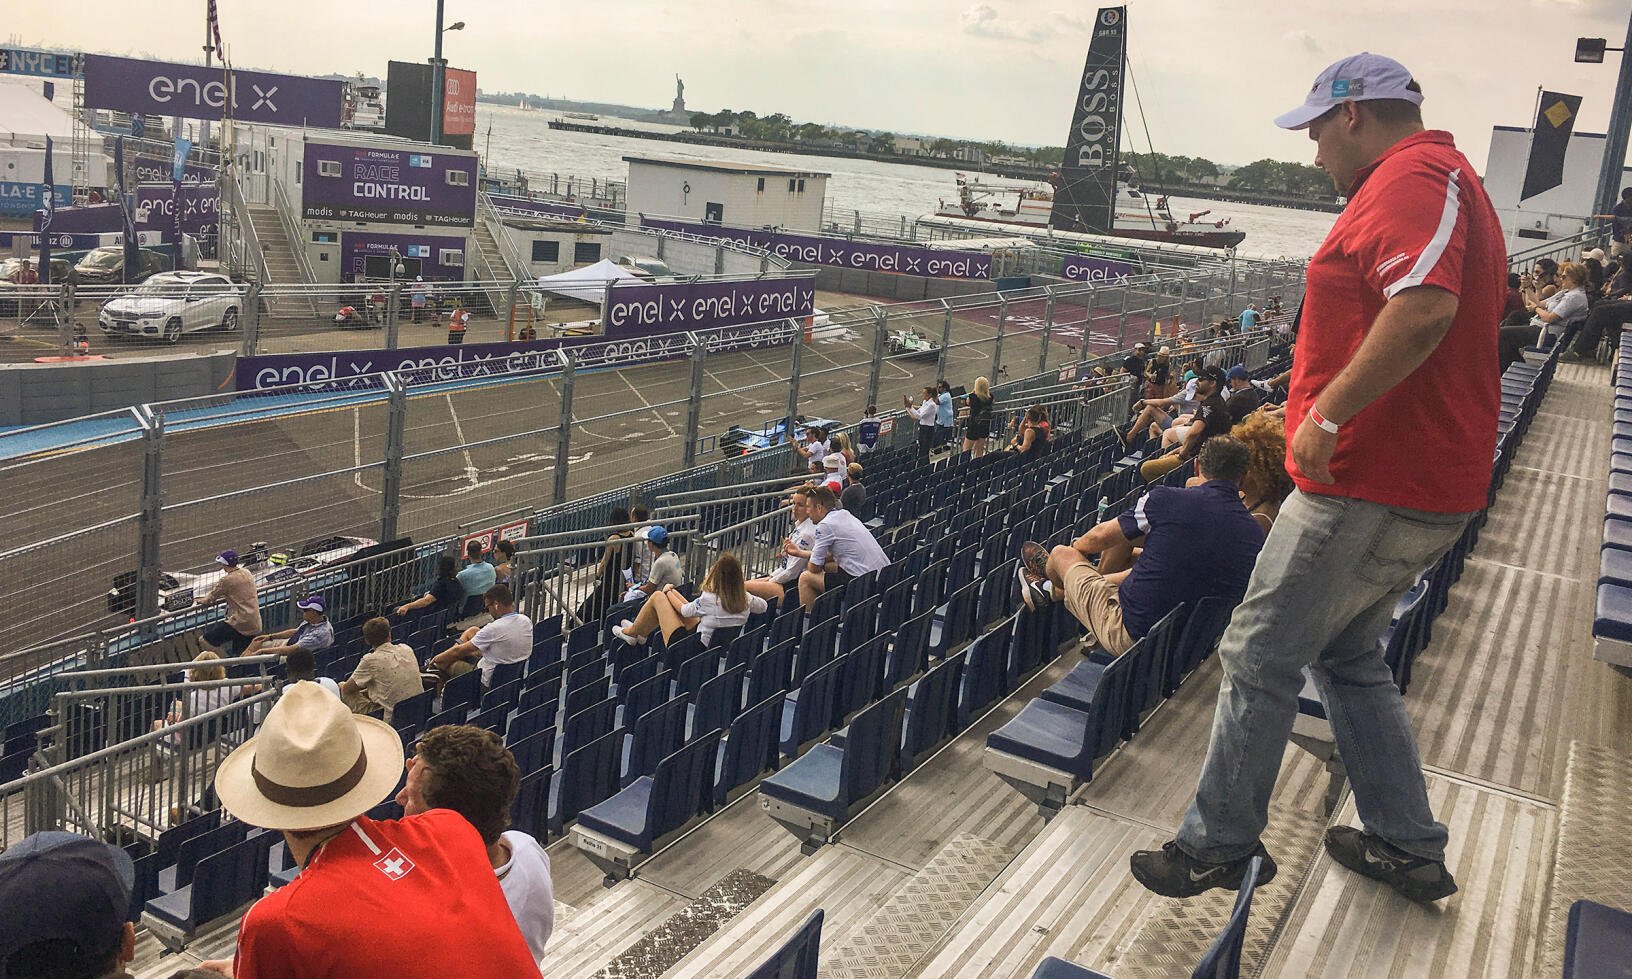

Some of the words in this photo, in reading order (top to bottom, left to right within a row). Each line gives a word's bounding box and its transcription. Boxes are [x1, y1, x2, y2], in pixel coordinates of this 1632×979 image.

[148, 75, 238, 109] enel
[1109, 69, 1119, 113] BOSS
[1078, 69, 1110, 167] BOSS
[1105, 124, 1115, 167] HUGO
[353, 163, 400, 182] RACE
[140, 198, 174, 215] ene
[200, 196, 220, 214] ene
[353, 182, 431, 201] CONTROL
[307, 206, 333, 217] modis
[393, 211, 418, 221] modis
[775, 243, 822, 263] enel
[850, 252, 899, 270] enel
[927, 258, 970, 276] enel
[1065, 267, 1109, 282] enel
[610, 294, 663, 326] enel
[692, 290, 736, 320] enel
[758, 286, 797, 314] enel
[255, 357, 337, 391] enel
[397, 349, 464, 383] enel
[604, 336, 651, 364] enel
[750, 321, 785, 347] enel
